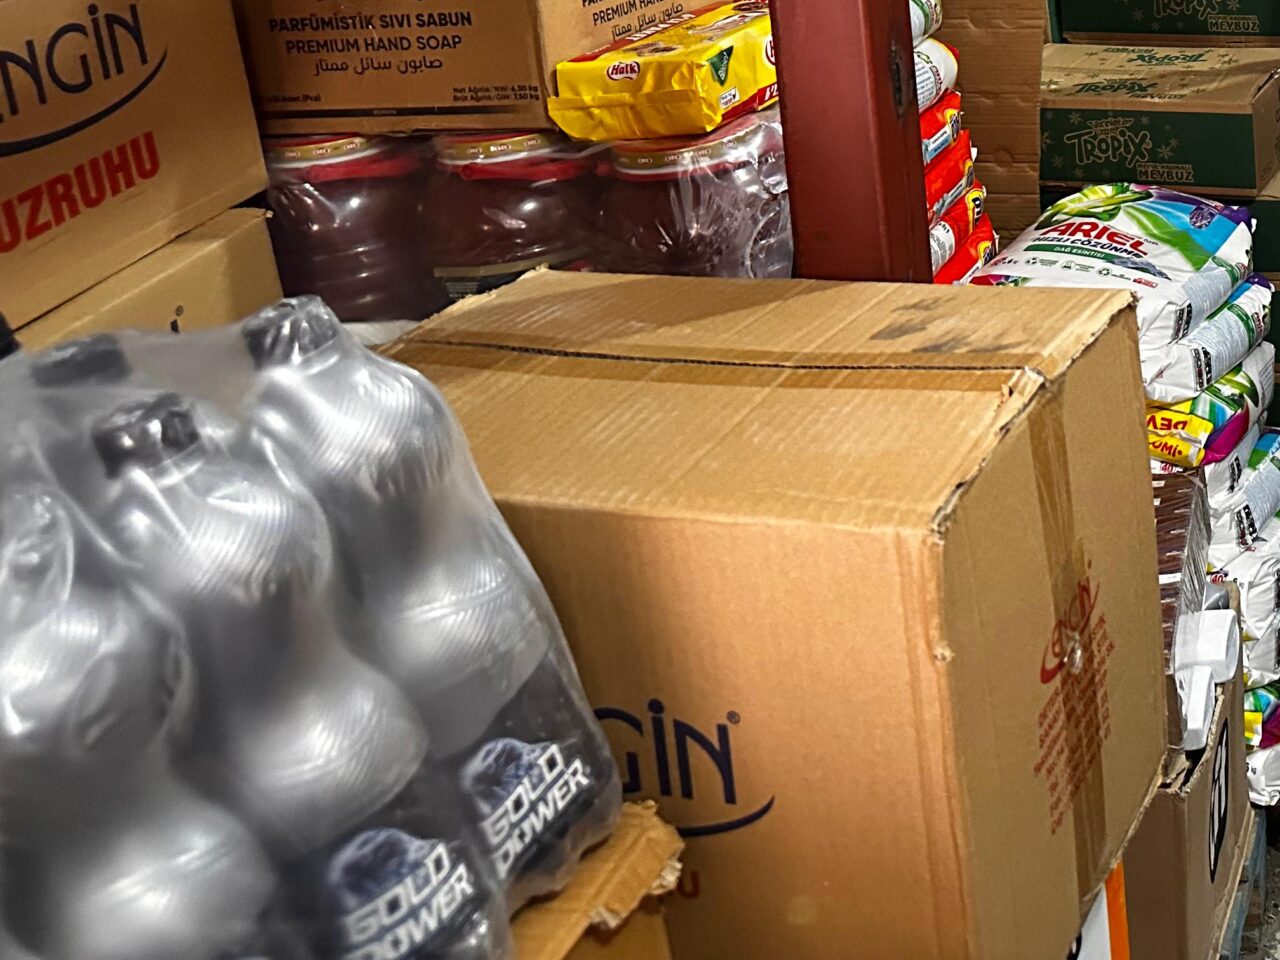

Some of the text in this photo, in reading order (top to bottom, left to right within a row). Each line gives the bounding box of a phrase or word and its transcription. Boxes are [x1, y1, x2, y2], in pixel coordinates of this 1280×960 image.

[269, 11, 472, 33] PARFÜMİSTİK SIVI SABUN
[593, 0, 637, 26] PREMIUM
[1208, 21, 1259, 32] MEYBUZ
[286, 34, 462, 54] PREMIUM HAND SOAP
[0, 3, 148, 124] NGİN
[314, 56, 443, 77] صابون سائل ممتاز
[609, 62, 639, 78] Halk
[1138, 169, 1194, 182] MEYBUZ
[1032, 236, 1070, 245] HIZLI
[1040, 221, 1148, 256] ARIEL
[1053, 246, 1071, 254] DAĞ
[493, 759, 590, 881] POWER
